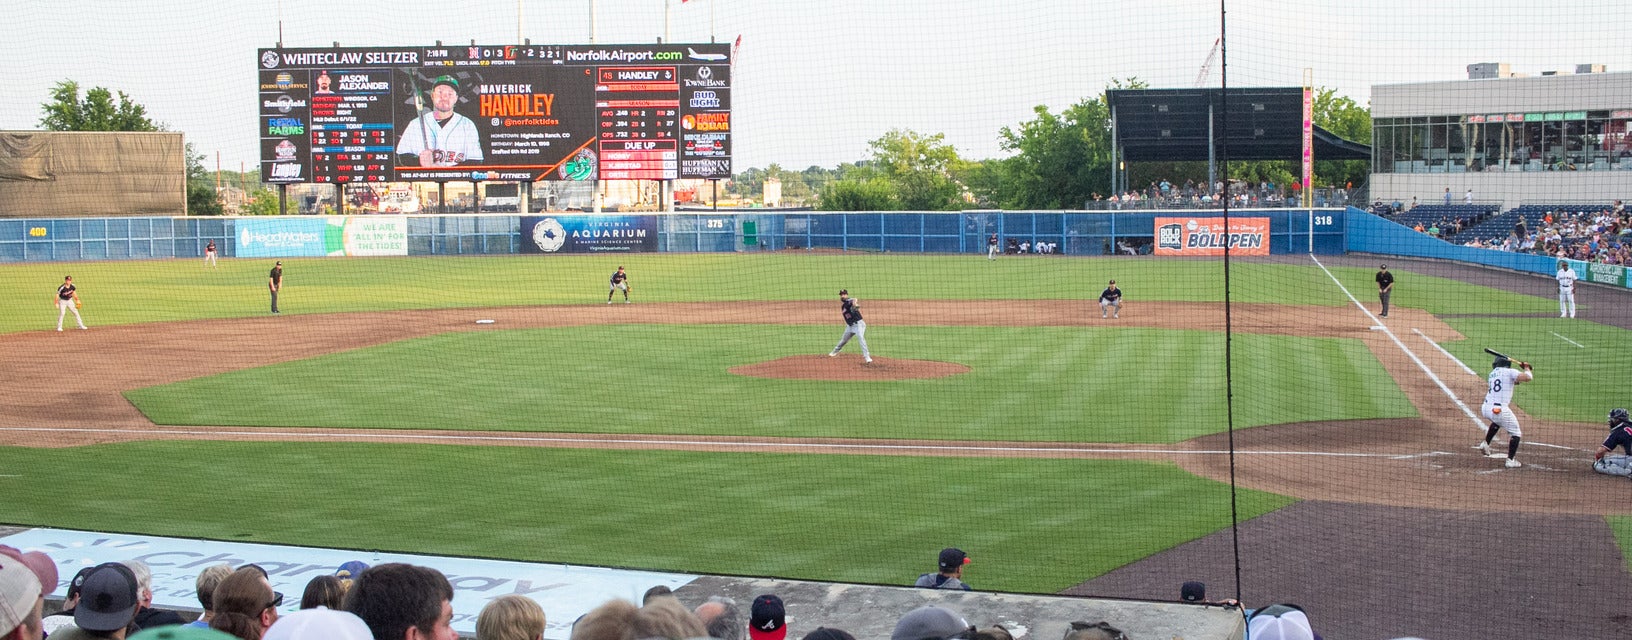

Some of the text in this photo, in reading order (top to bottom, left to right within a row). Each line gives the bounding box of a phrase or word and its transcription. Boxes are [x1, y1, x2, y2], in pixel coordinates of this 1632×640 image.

[528, 49, 534, 57] 2
[566, 50, 682, 62] NorfolkAirport.com
[282, 52, 362, 65] WHITECLAW
[365, 51, 418, 64] SELTZER
[339, 75, 368, 83] JASON
[618, 72, 659, 80] HANDLEY
[340, 82, 388, 90] ALEXANDER
[480, 84, 532, 94] MAVERICK
[264, 100, 306, 109] Smithfield
[480, 94, 554, 117] HANDLEY
[690, 99, 720, 107] LIGHT
[269, 118, 304, 126] ROYAL
[696, 113, 729, 122] FAMILY
[269, 126, 304, 135] FARMS
[696, 122, 729, 130] DOLLAR
[272, 162, 302, 177] Langley
[707, 220, 723, 229] 375
[1315, 216, 1333, 225] 318
[30, 227, 47, 236] 400
[572, 228, 646, 238] AQUARIUM
[1160, 228, 1180, 236] BOLD
[251, 232, 319, 242] HeadWaters
[1187, 233, 1263, 248] BOLDPEN
[133, 552, 573, 600] Charay
